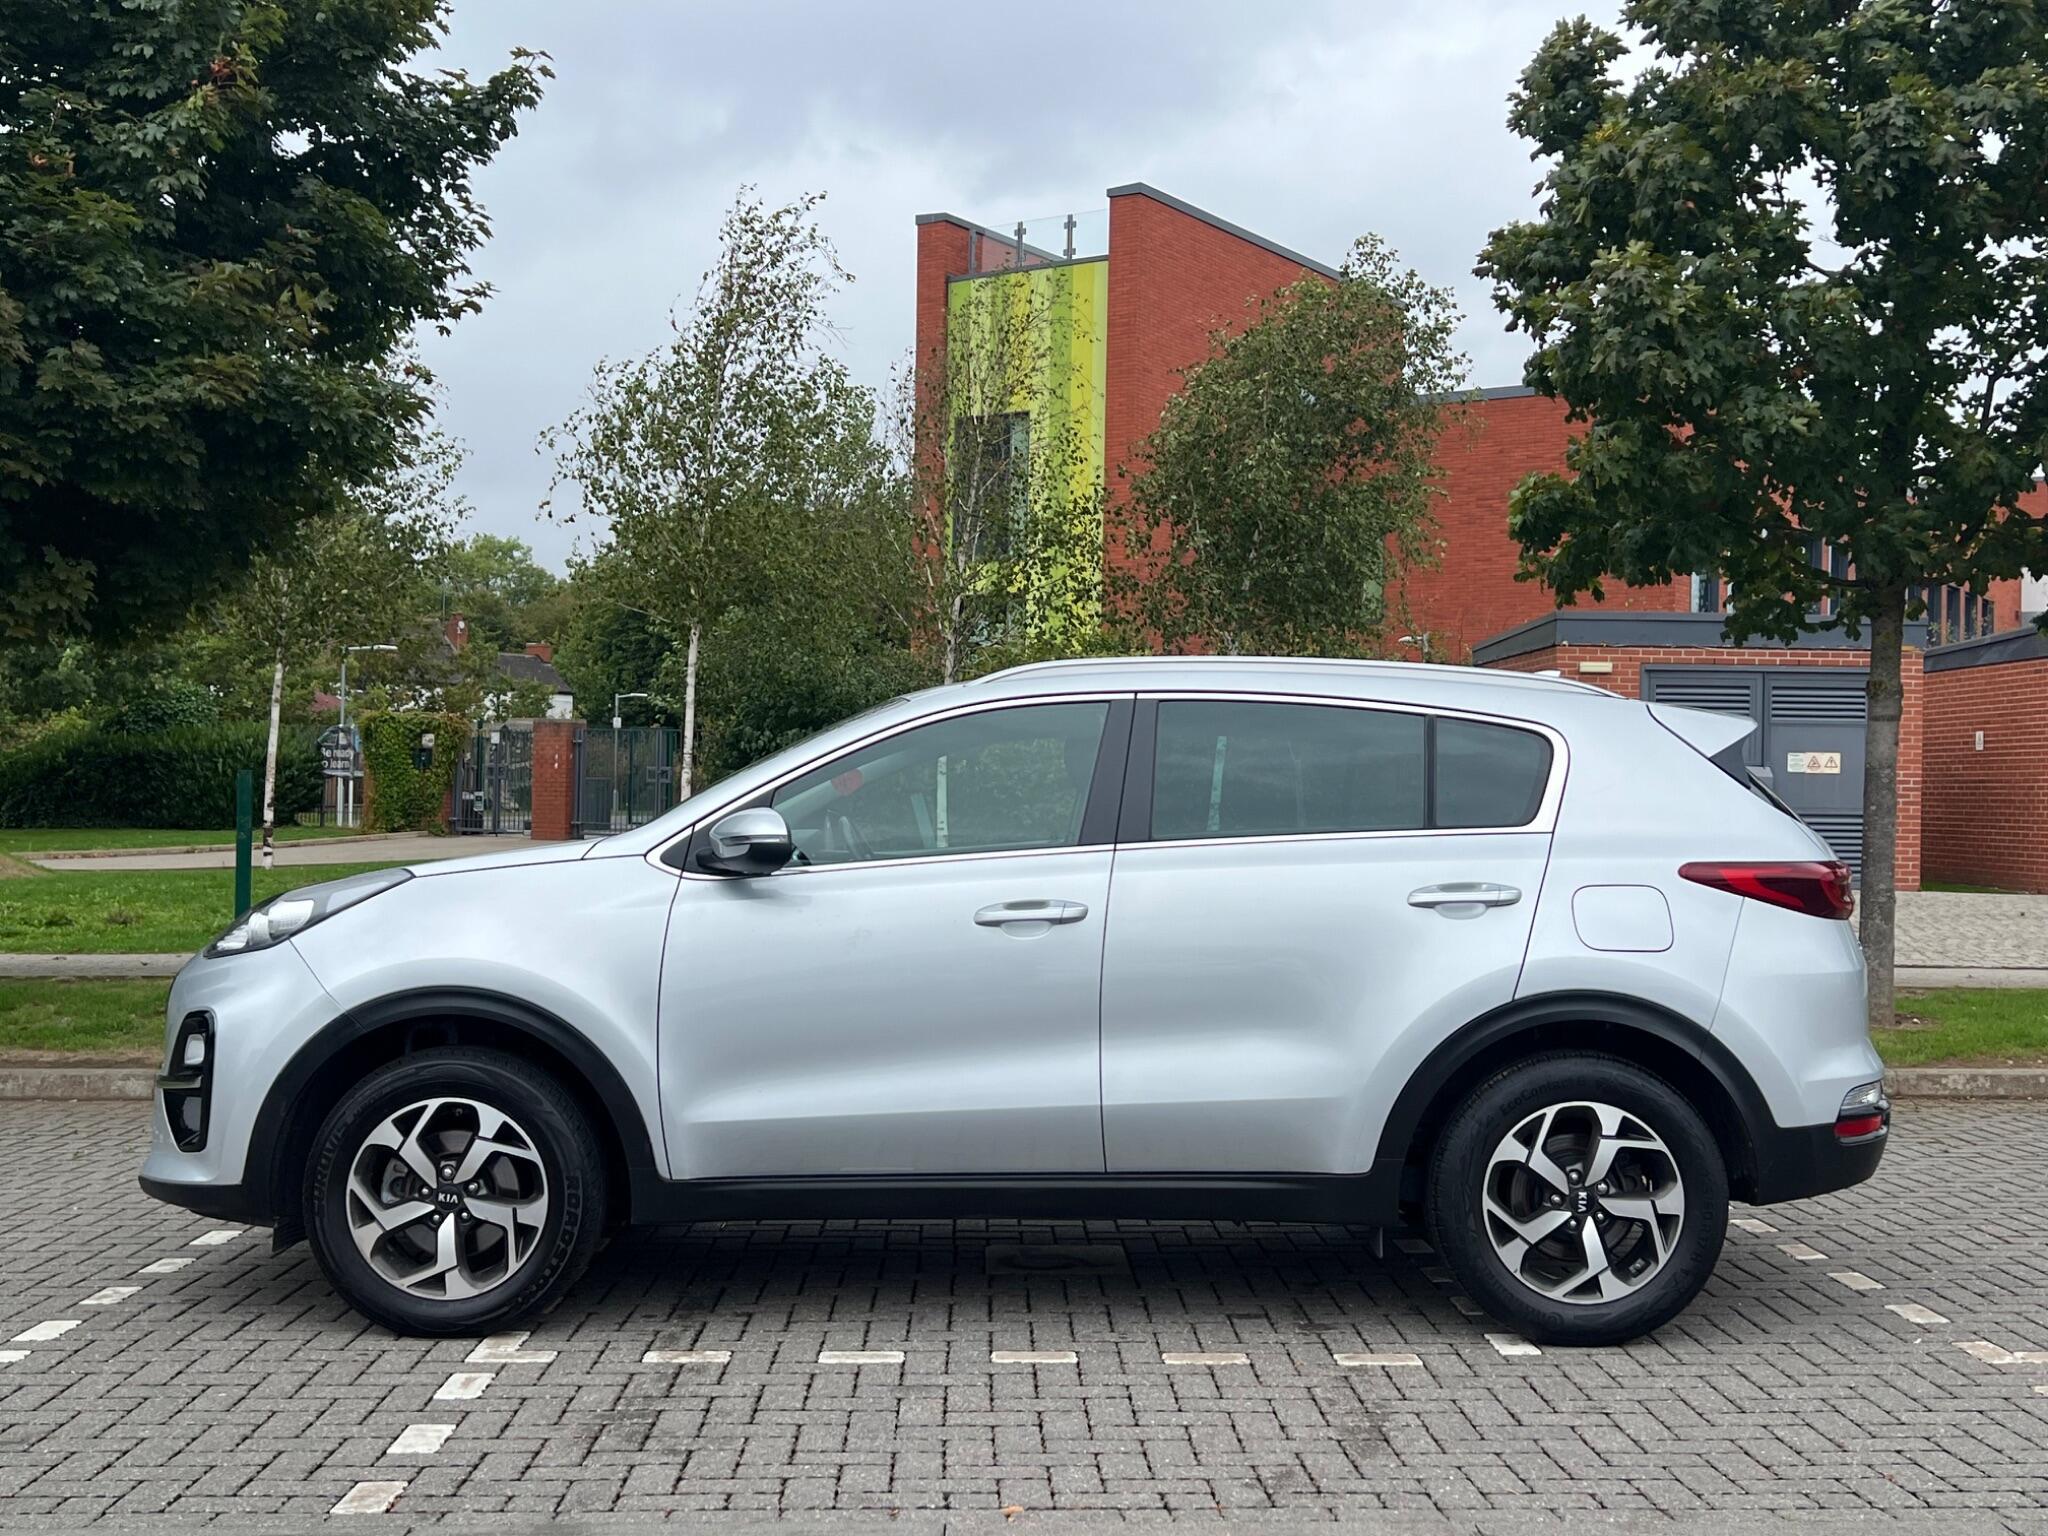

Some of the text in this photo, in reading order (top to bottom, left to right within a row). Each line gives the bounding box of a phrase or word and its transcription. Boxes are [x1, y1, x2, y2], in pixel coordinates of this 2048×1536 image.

[333, 748, 354, 760] ready
[330, 758, 350, 768] learn
[437, 1192, 459, 1204] KIA
[1577, 1191, 1588, 1213] KIA
